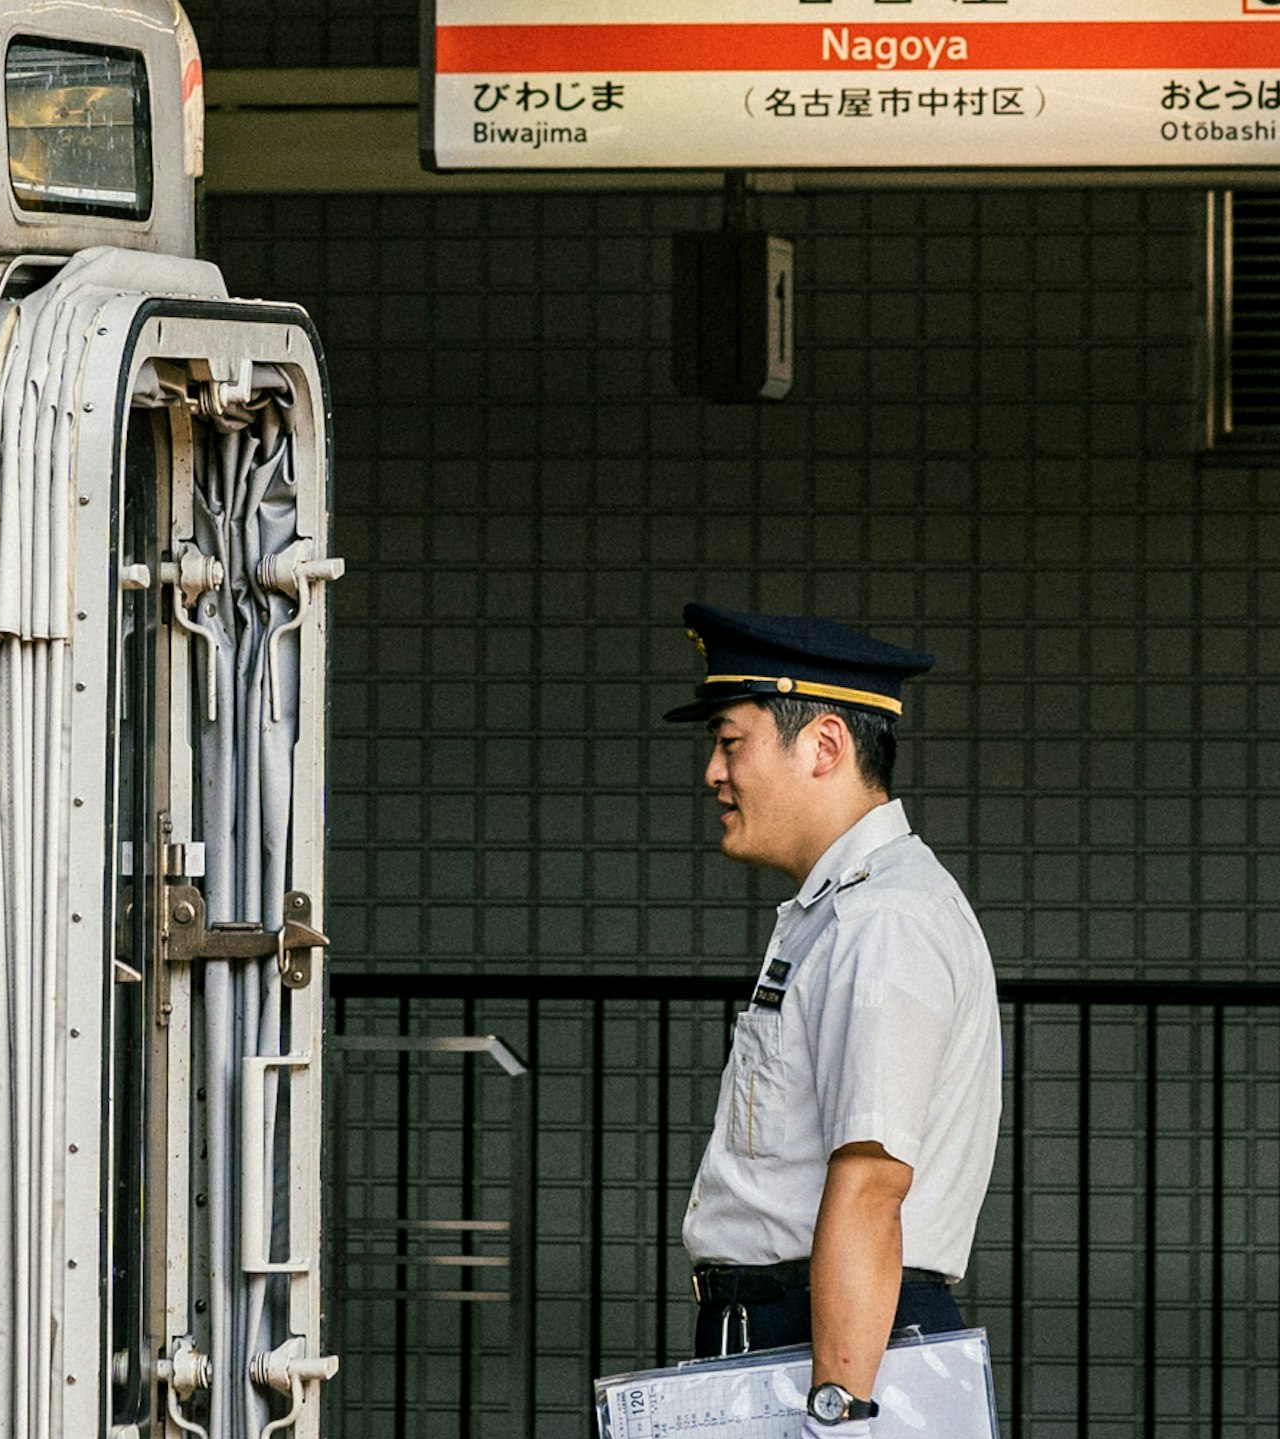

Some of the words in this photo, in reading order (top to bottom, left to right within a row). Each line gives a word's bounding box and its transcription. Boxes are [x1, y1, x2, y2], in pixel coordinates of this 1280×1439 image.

[821, 27, 970, 70] Nagoya
[473, 80, 625, 113] びわじま
[473, 121, 588, 150] Biwajima
[1160, 120, 1277, 141] Otōbashi
[630, 1389, 645, 1416] 120
